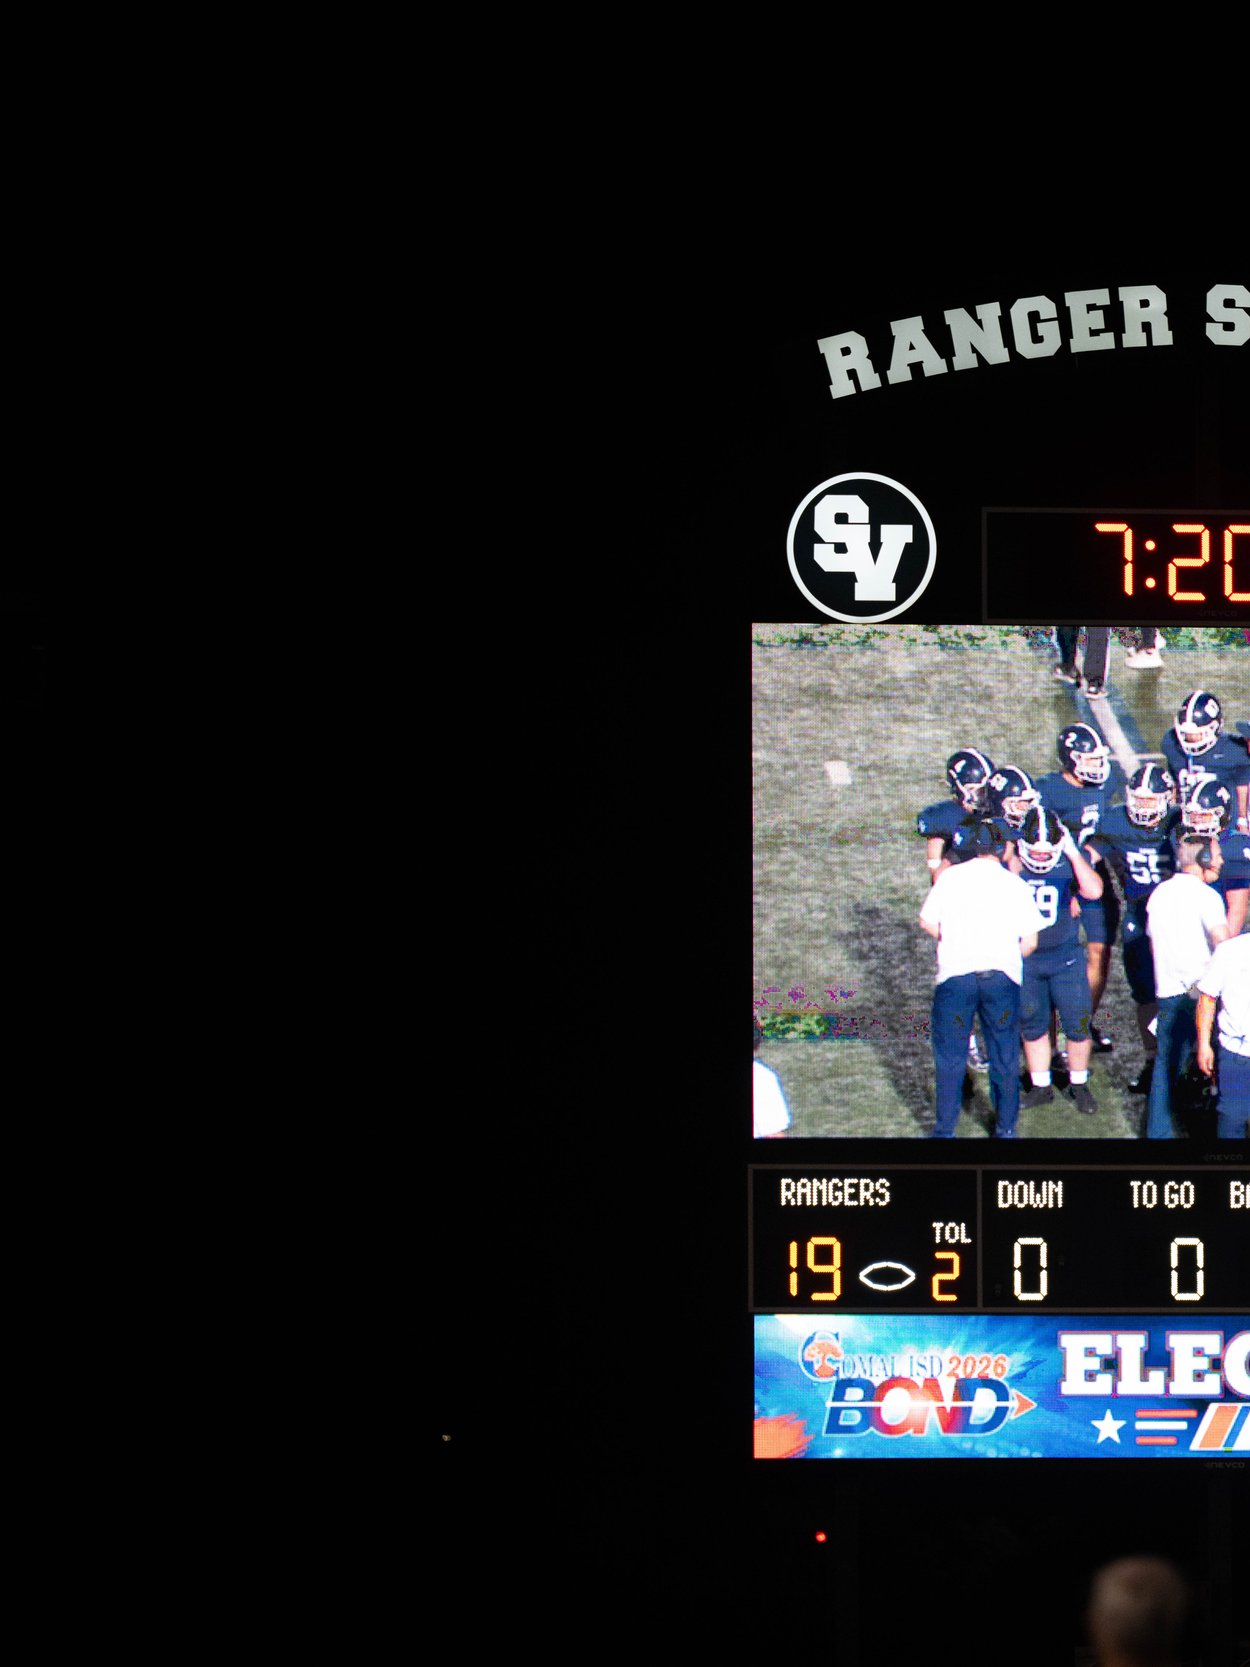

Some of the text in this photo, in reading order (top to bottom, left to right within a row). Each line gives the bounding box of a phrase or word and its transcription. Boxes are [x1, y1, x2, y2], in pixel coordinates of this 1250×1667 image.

[817, 285, 1173, 399] RANGER
[814, 495, 913, 601] SV
[781, 1178, 890, 1206] RANGERS
[998, 1181, 1063, 1208] DOWN
[1130, 1181, 1195, 1208] TO GO
[932, 1222, 972, 1243] TOL
[789, 1237, 841, 1301] 19
[932, 1252, 960, 1301] 2
[1013, 1237, 1048, 1300] 0
[1171, 1238, 1205, 1301] 0
[908, 1355, 943, 1378] ISD
[946, 1355, 1008, 1379] 2026
[825, 1378, 1010, 1435] BOND
